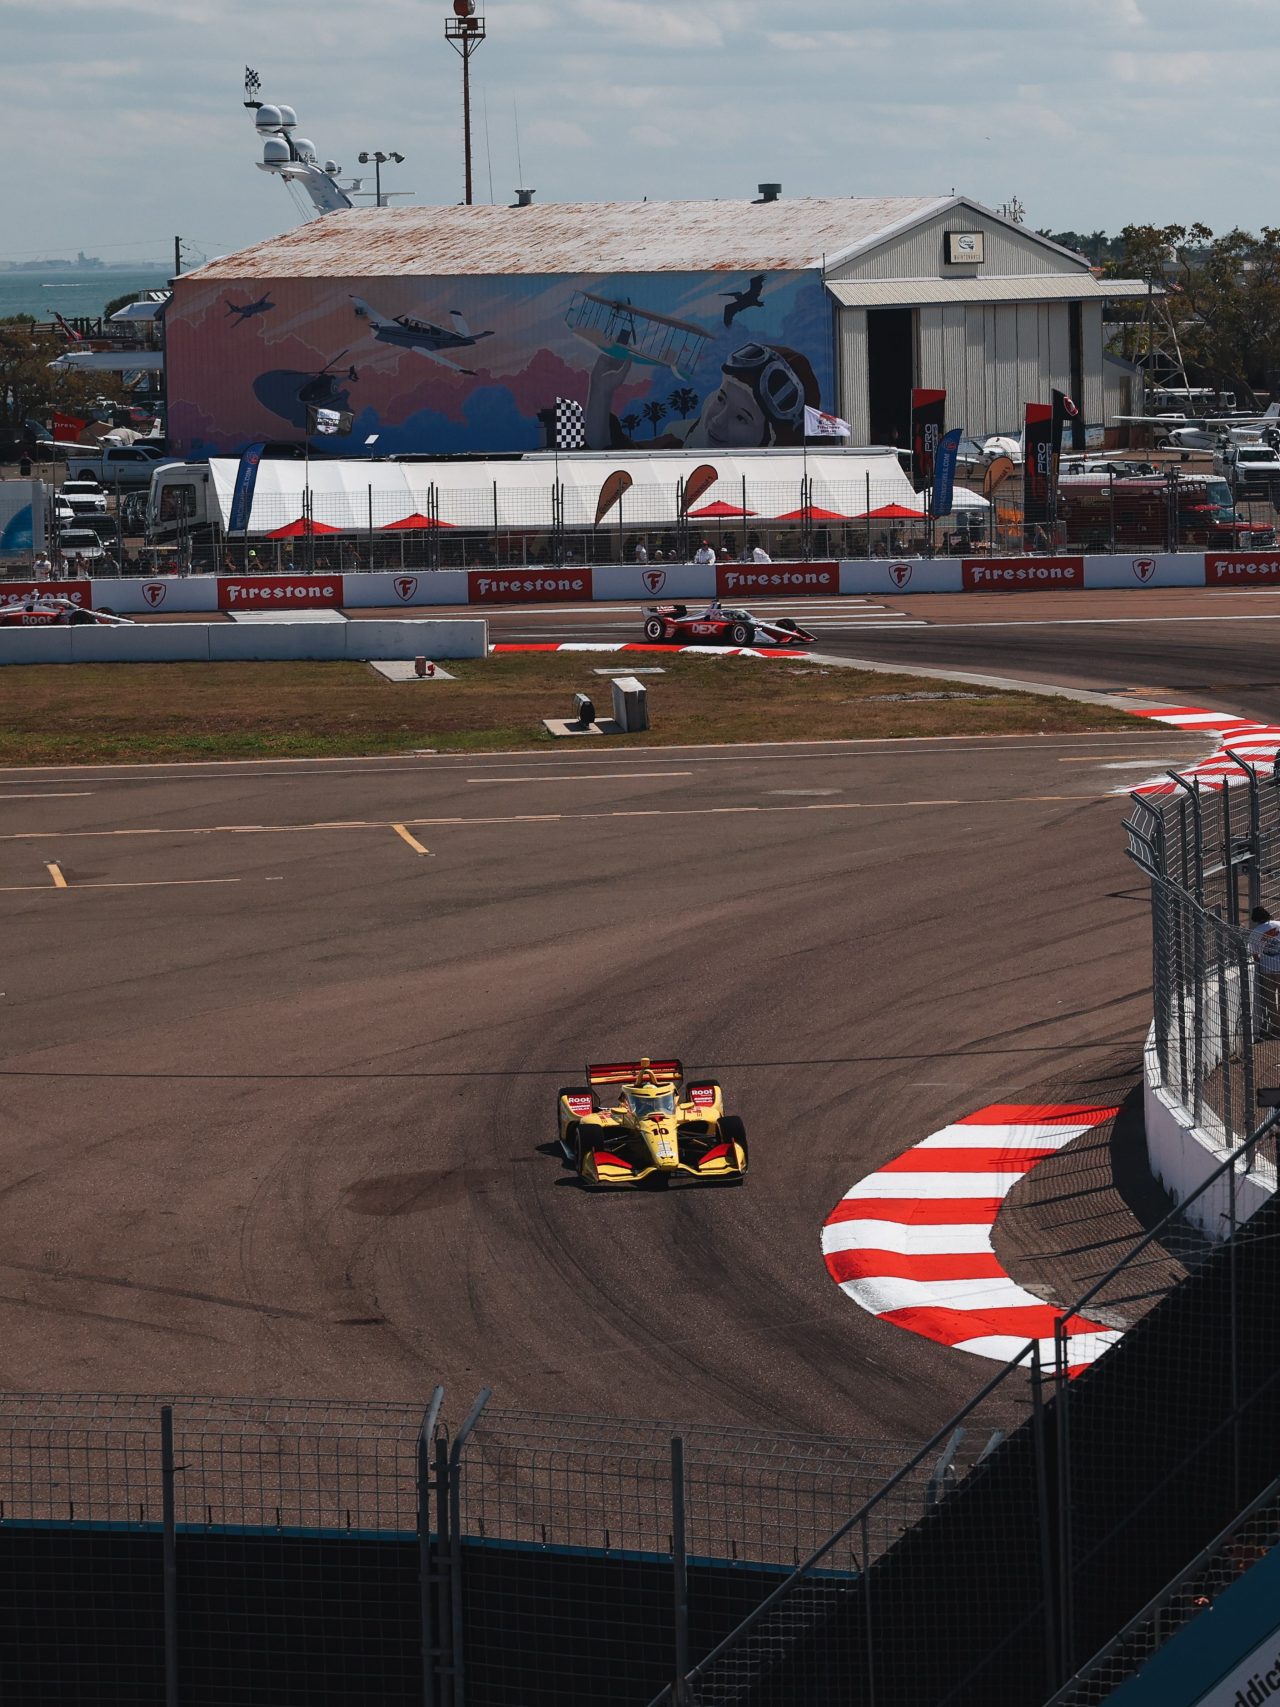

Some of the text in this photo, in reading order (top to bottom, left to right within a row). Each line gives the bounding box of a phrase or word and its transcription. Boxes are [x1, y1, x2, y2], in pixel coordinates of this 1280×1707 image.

[924, 423, 932, 452] PRO
[1037, 442, 1046, 474] PRO
[725, 571, 831, 588] Firestone
[970, 566, 1075, 583] Firestone
[226, 585, 334, 602] Firestone
[477, 577, 583, 595] Firestone
[692, 624, 718, 633] DEX
[691, 1088, 713, 1096] Root
[651, 1128, 669, 1136] 10
